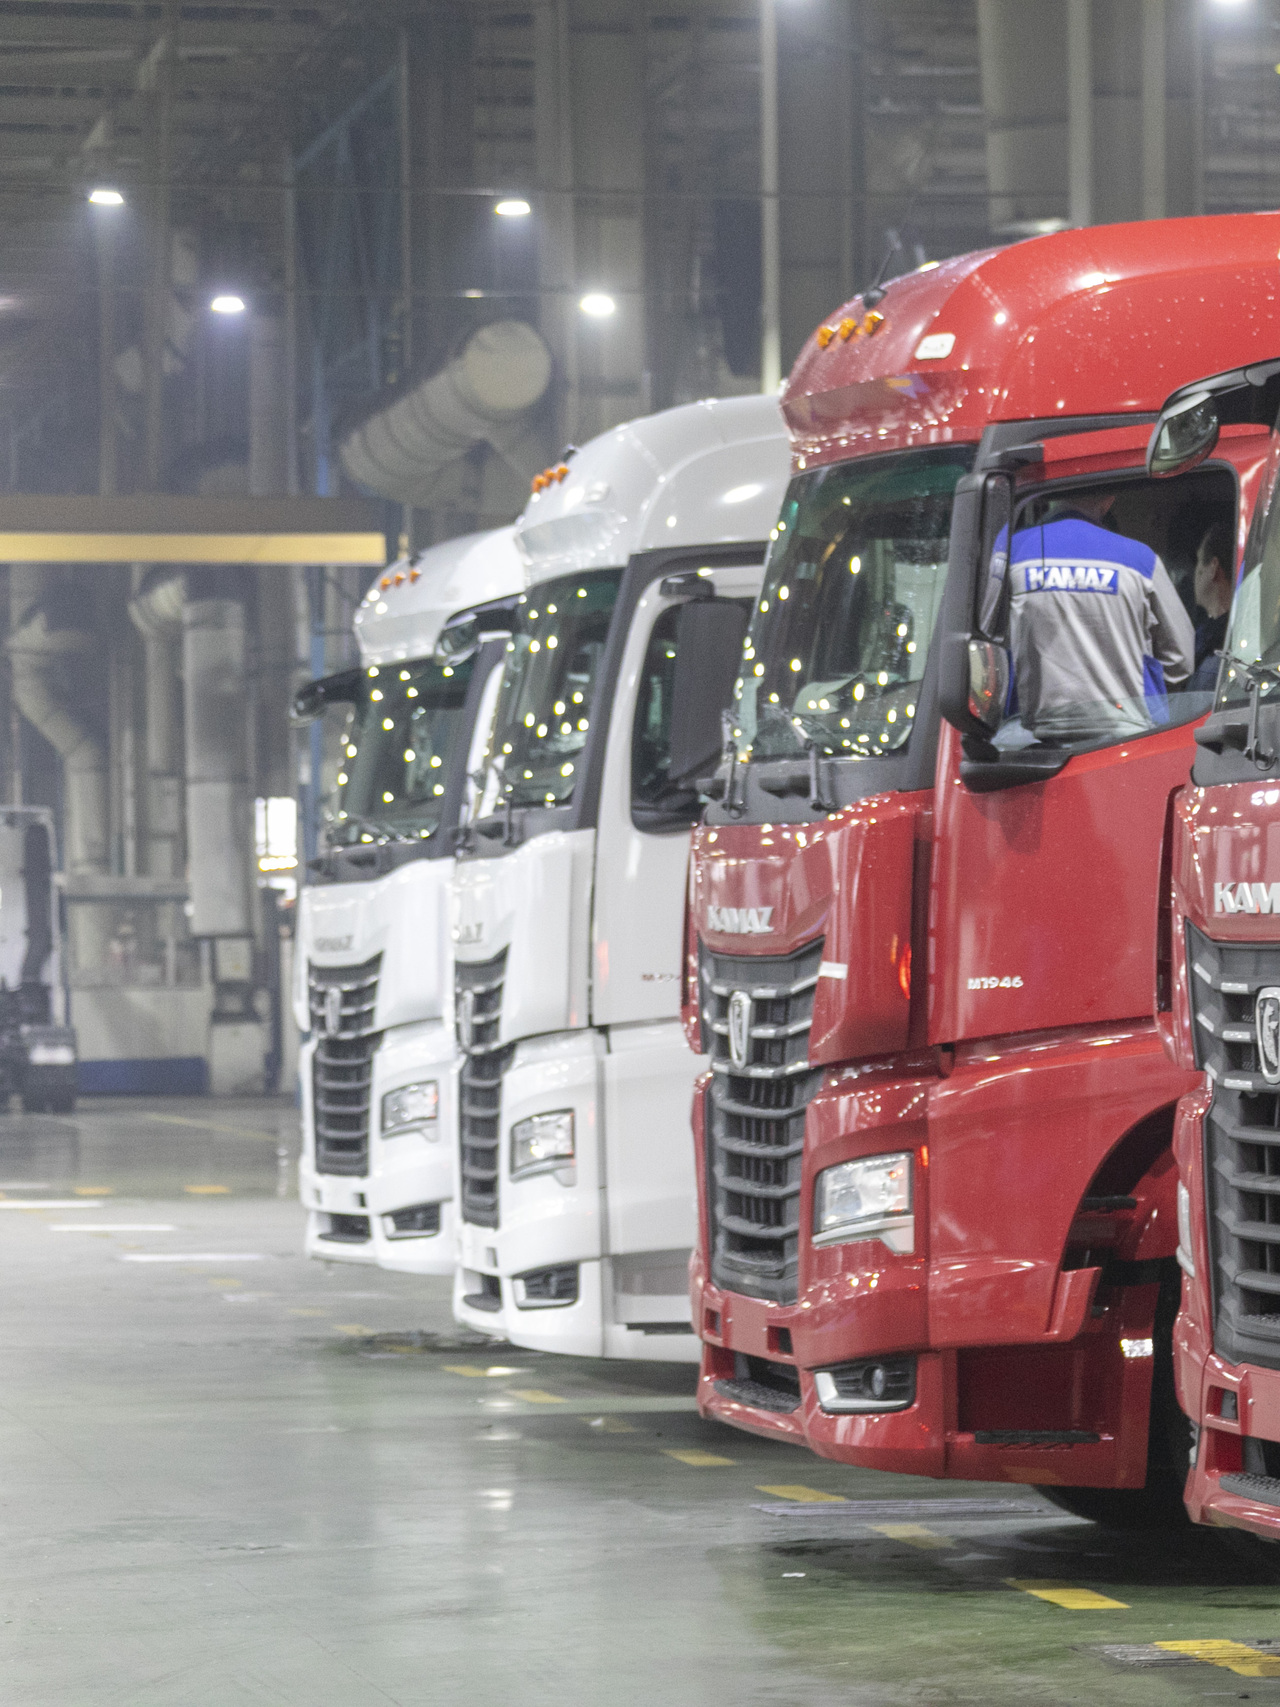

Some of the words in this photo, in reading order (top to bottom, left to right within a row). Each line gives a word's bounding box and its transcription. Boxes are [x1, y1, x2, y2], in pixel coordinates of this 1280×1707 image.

[1027, 566, 1115, 593] KAMAZ
[707, 904, 776, 935] KAMAZ
[967, 975, 1024, 990] M1946
